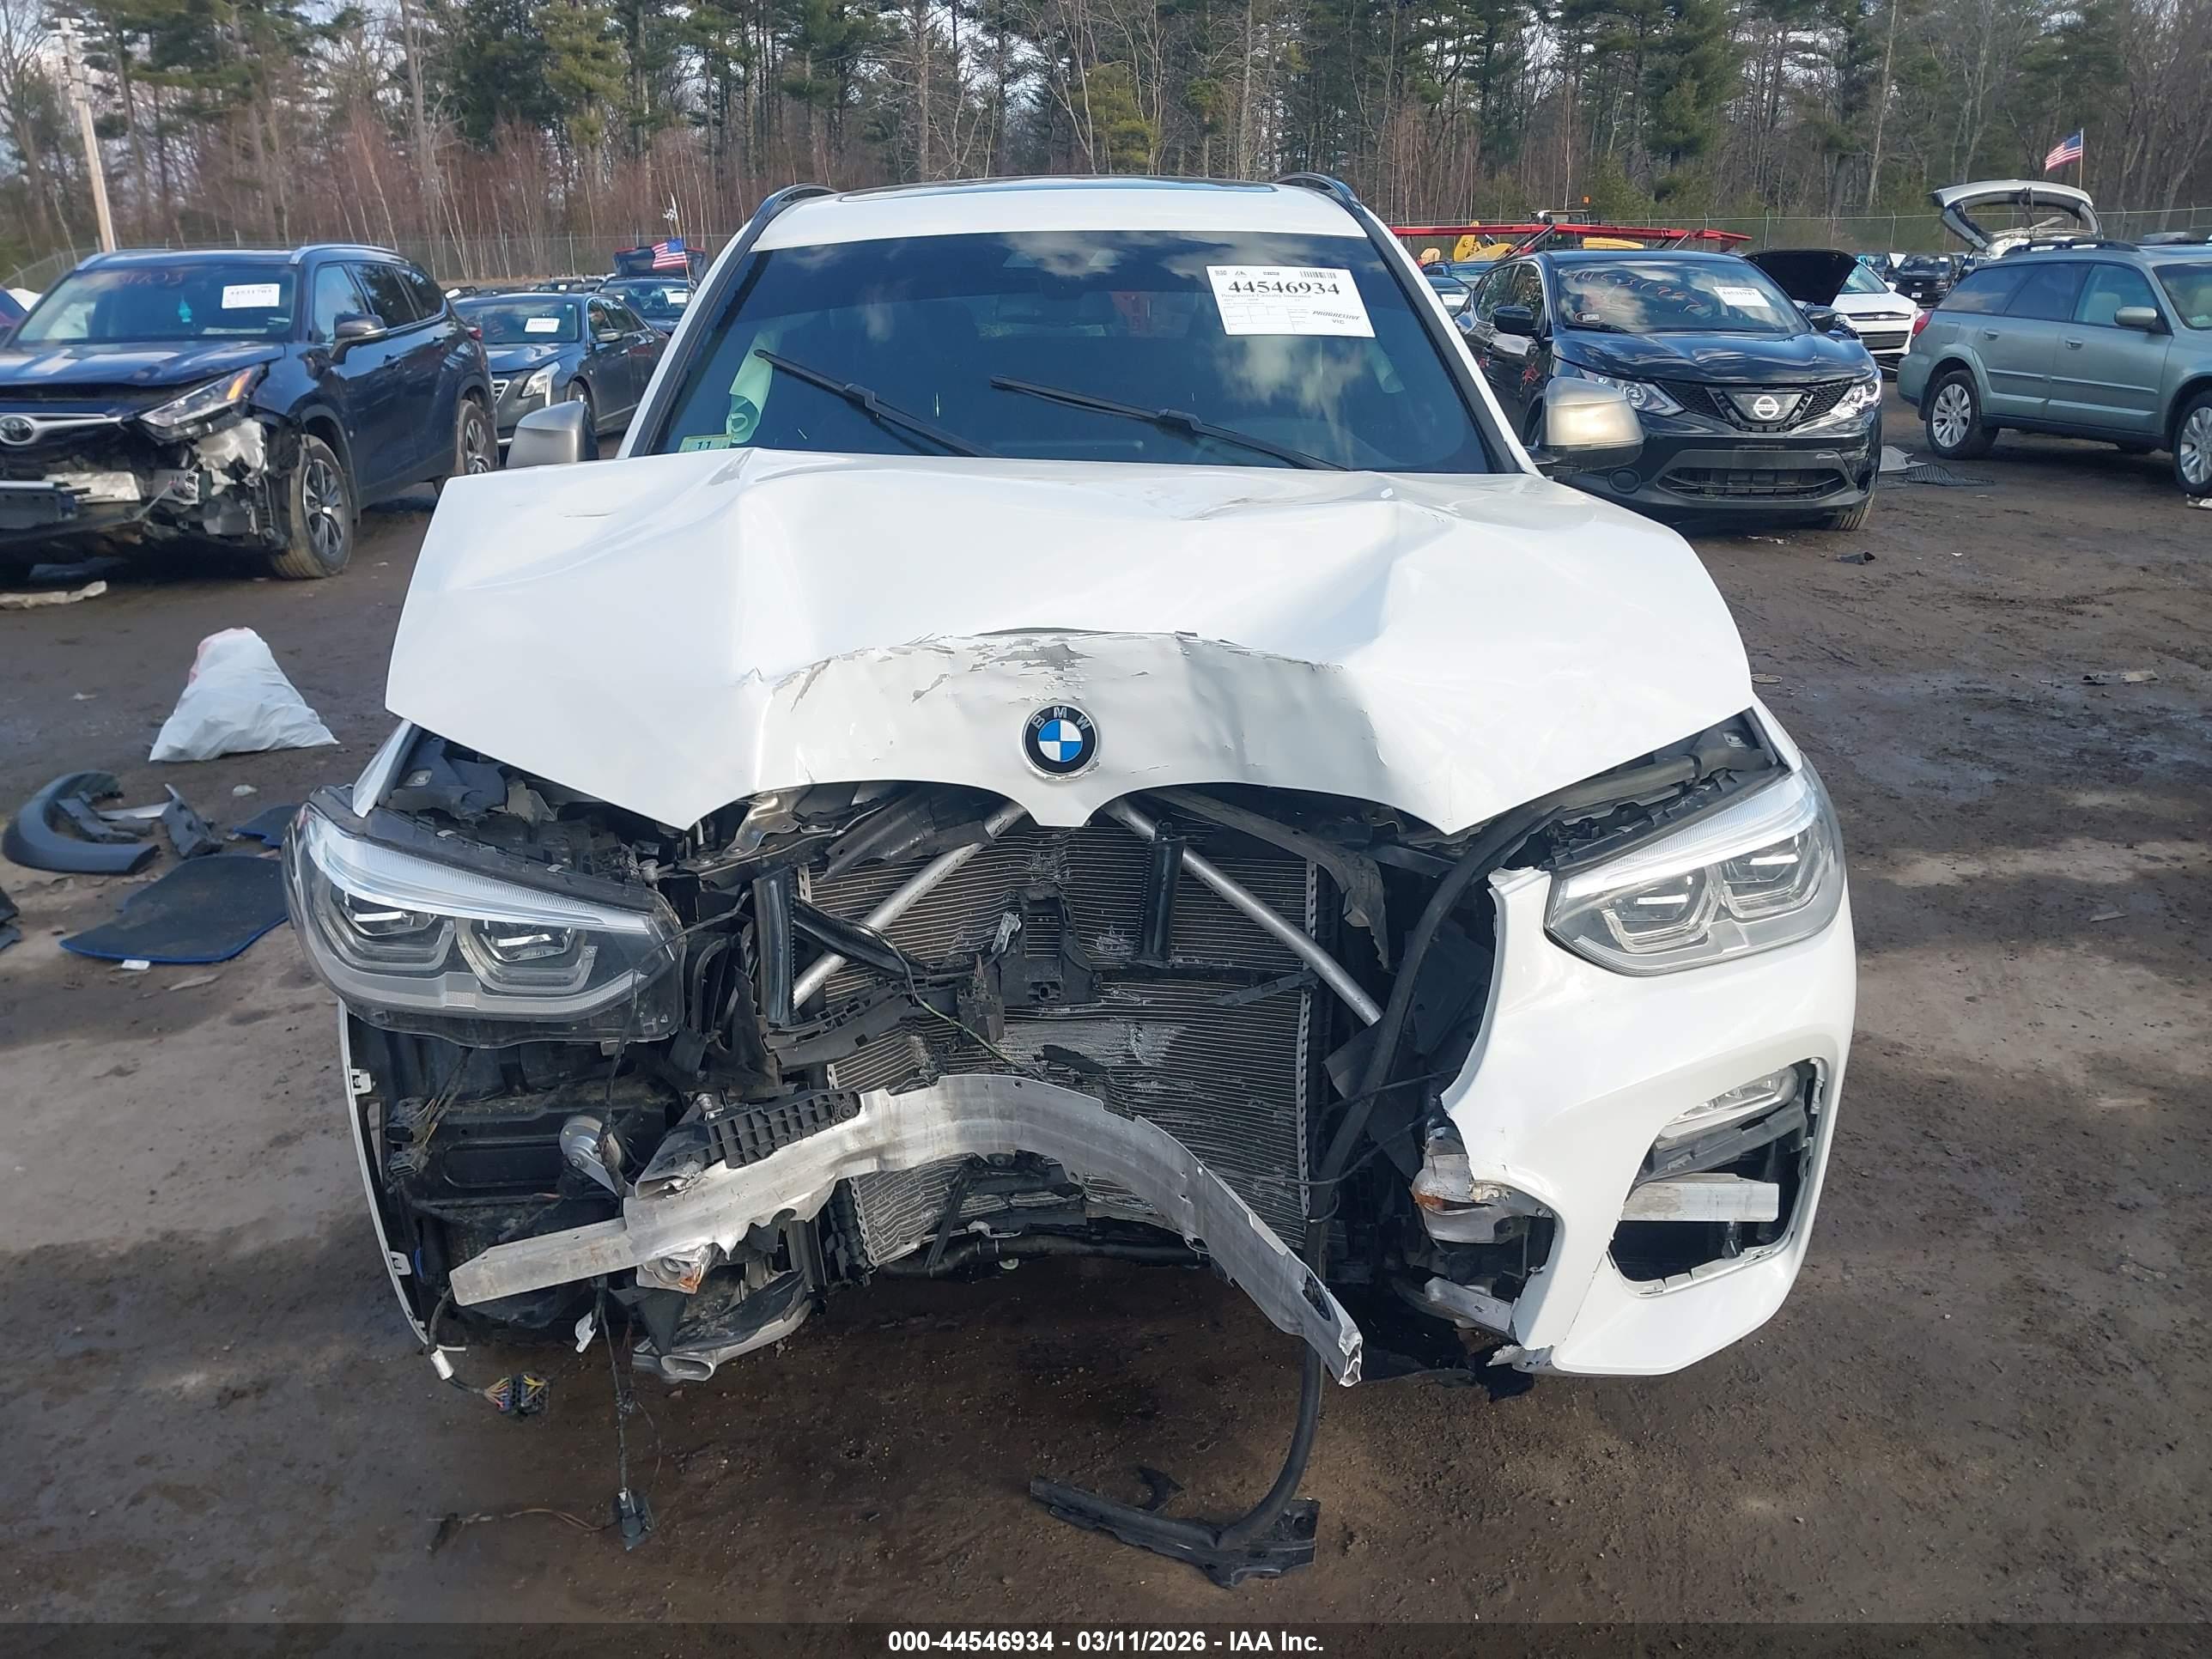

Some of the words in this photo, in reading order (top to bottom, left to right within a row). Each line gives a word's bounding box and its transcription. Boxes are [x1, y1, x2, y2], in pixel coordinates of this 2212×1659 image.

[1228, 281, 1340, 295] 44546934
[697, 440, 712, 450] 11
[1030, 707, 1091, 731] BMW
